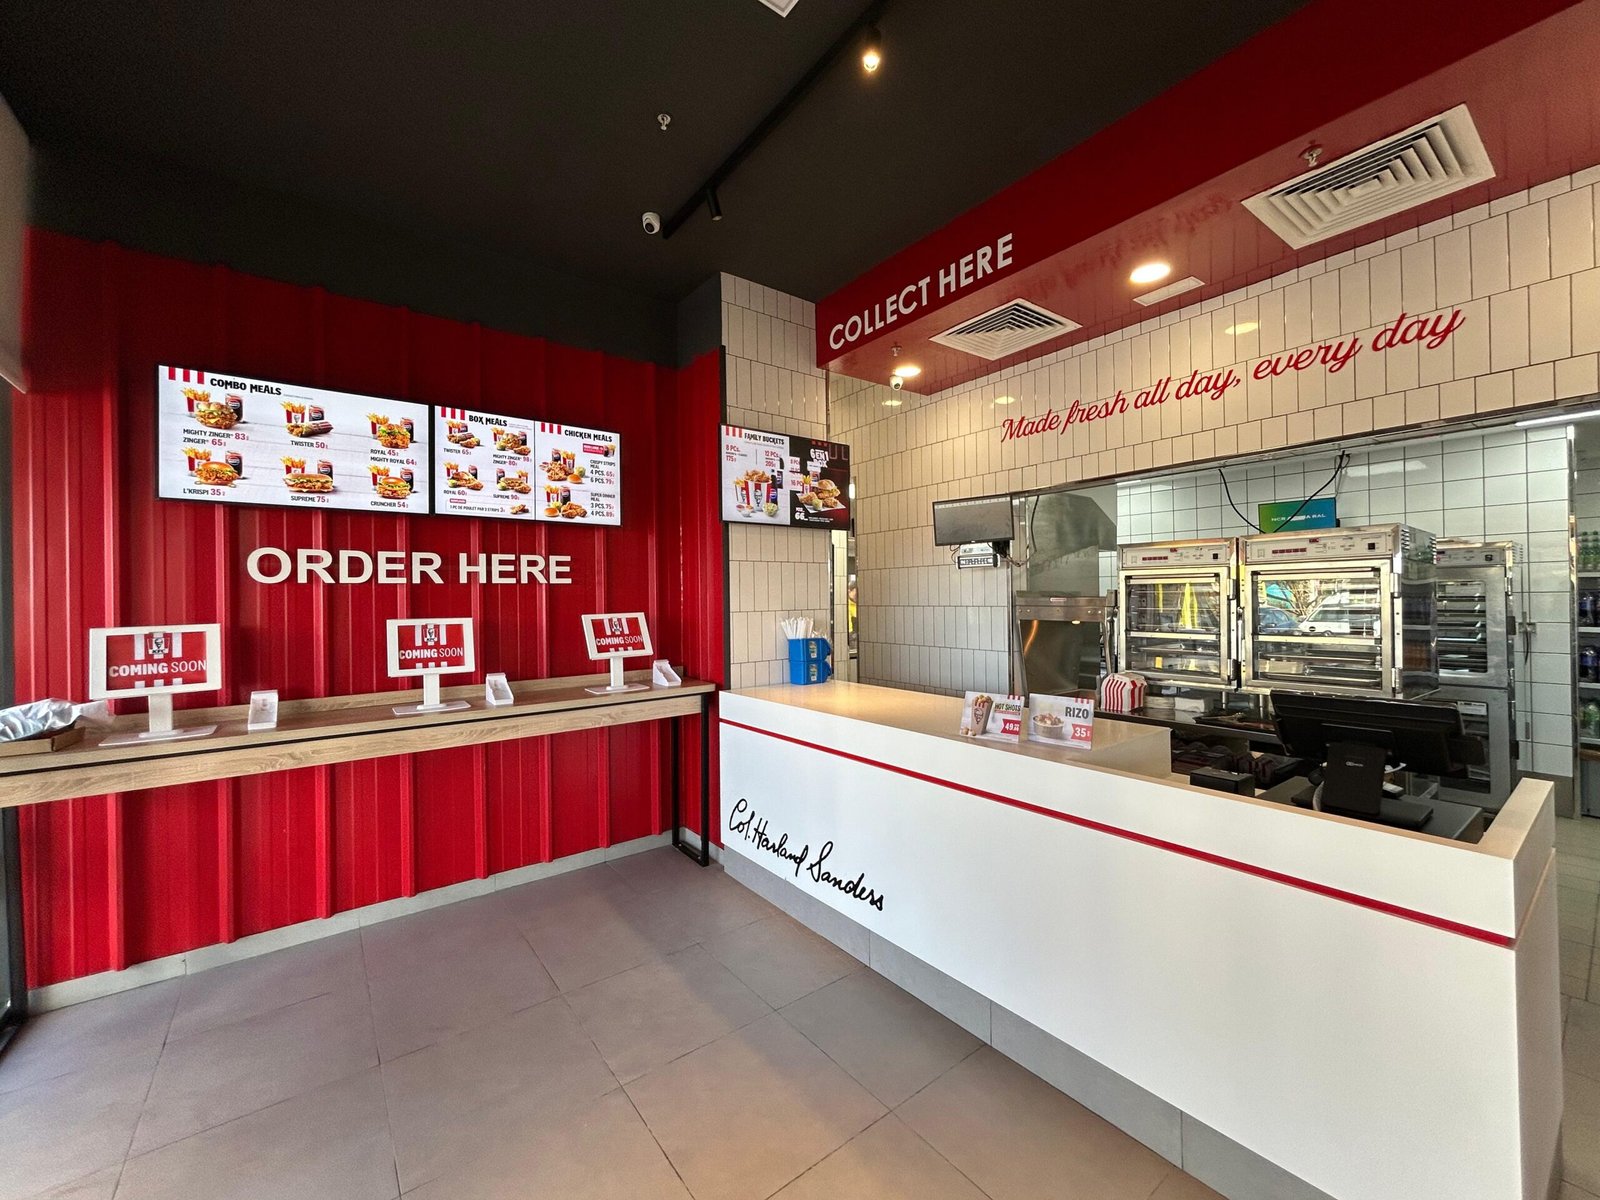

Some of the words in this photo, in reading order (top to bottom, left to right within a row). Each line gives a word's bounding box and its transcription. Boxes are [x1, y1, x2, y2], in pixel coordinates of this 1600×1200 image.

[829, 276, 930, 350] COLLECT
[939, 232, 1013, 298] HERE
[1001, 408, 1061, 443] Made
[1060, 391, 1128, 434] fresh
[1134, 376, 1172, 414] all
[1175, 366, 1241, 401] day,
[1253, 336, 1362, 381] every
[1372, 308, 1467, 351] day
[210, 378, 247, 391] COMBO
[250, 383, 282, 396] MEALS
[469, 415, 484, 425] BOX
[485, 417, 508, 427] MEALS
[183, 428, 207, 438] MIGHTY
[235, 432, 246, 441] 83
[564, 429, 592, 440] CHICKEN
[593, 433, 613, 443] MEALS
[744, 433, 762, 441] FAMILY
[763, 436, 785, 445] BUCKETS
[211, 438, 223, 446] 65
[290, 440, 314, 448] TWISTER
[315, 441, 326, 449] 50
[370, 448, 387, 456] ROYAL
[387, 449, 397, 457] 45
[370, 456, 390, 464] MIGHTY
[406, 458, 416, 466] 64
[210, 488, 221, 497] 35
[290, 495, 316, 503] SUPREME
[370, 501, 397, 509] CRUNCHER
[397, 501, 407, 509] 54
[794, 512, 805, 520] 66
[246, 547, 445, 585] ORDER
[459, 552, 573, 585] HERE
[596, 637, 624, 646] COMING
[625, 635, 643, 644] SOON
[399, 649, 437, 659] COMING
[439, 647, 464, 657] SOON
[109, 662, 169, 678] COMING
[171, 659, 207, 673] SOON
[995, 702, 1005, 710] HOT
[1005, 704, 1021, 712] SHOTS
[1065, 707, 1090, 720] RIZO
[1075, 727, 1087, 738] 35
[729, 798, 755, 841] Col.
[752, 817, 808, 877] Harland
[806, 841, 884, 911] Sanders
